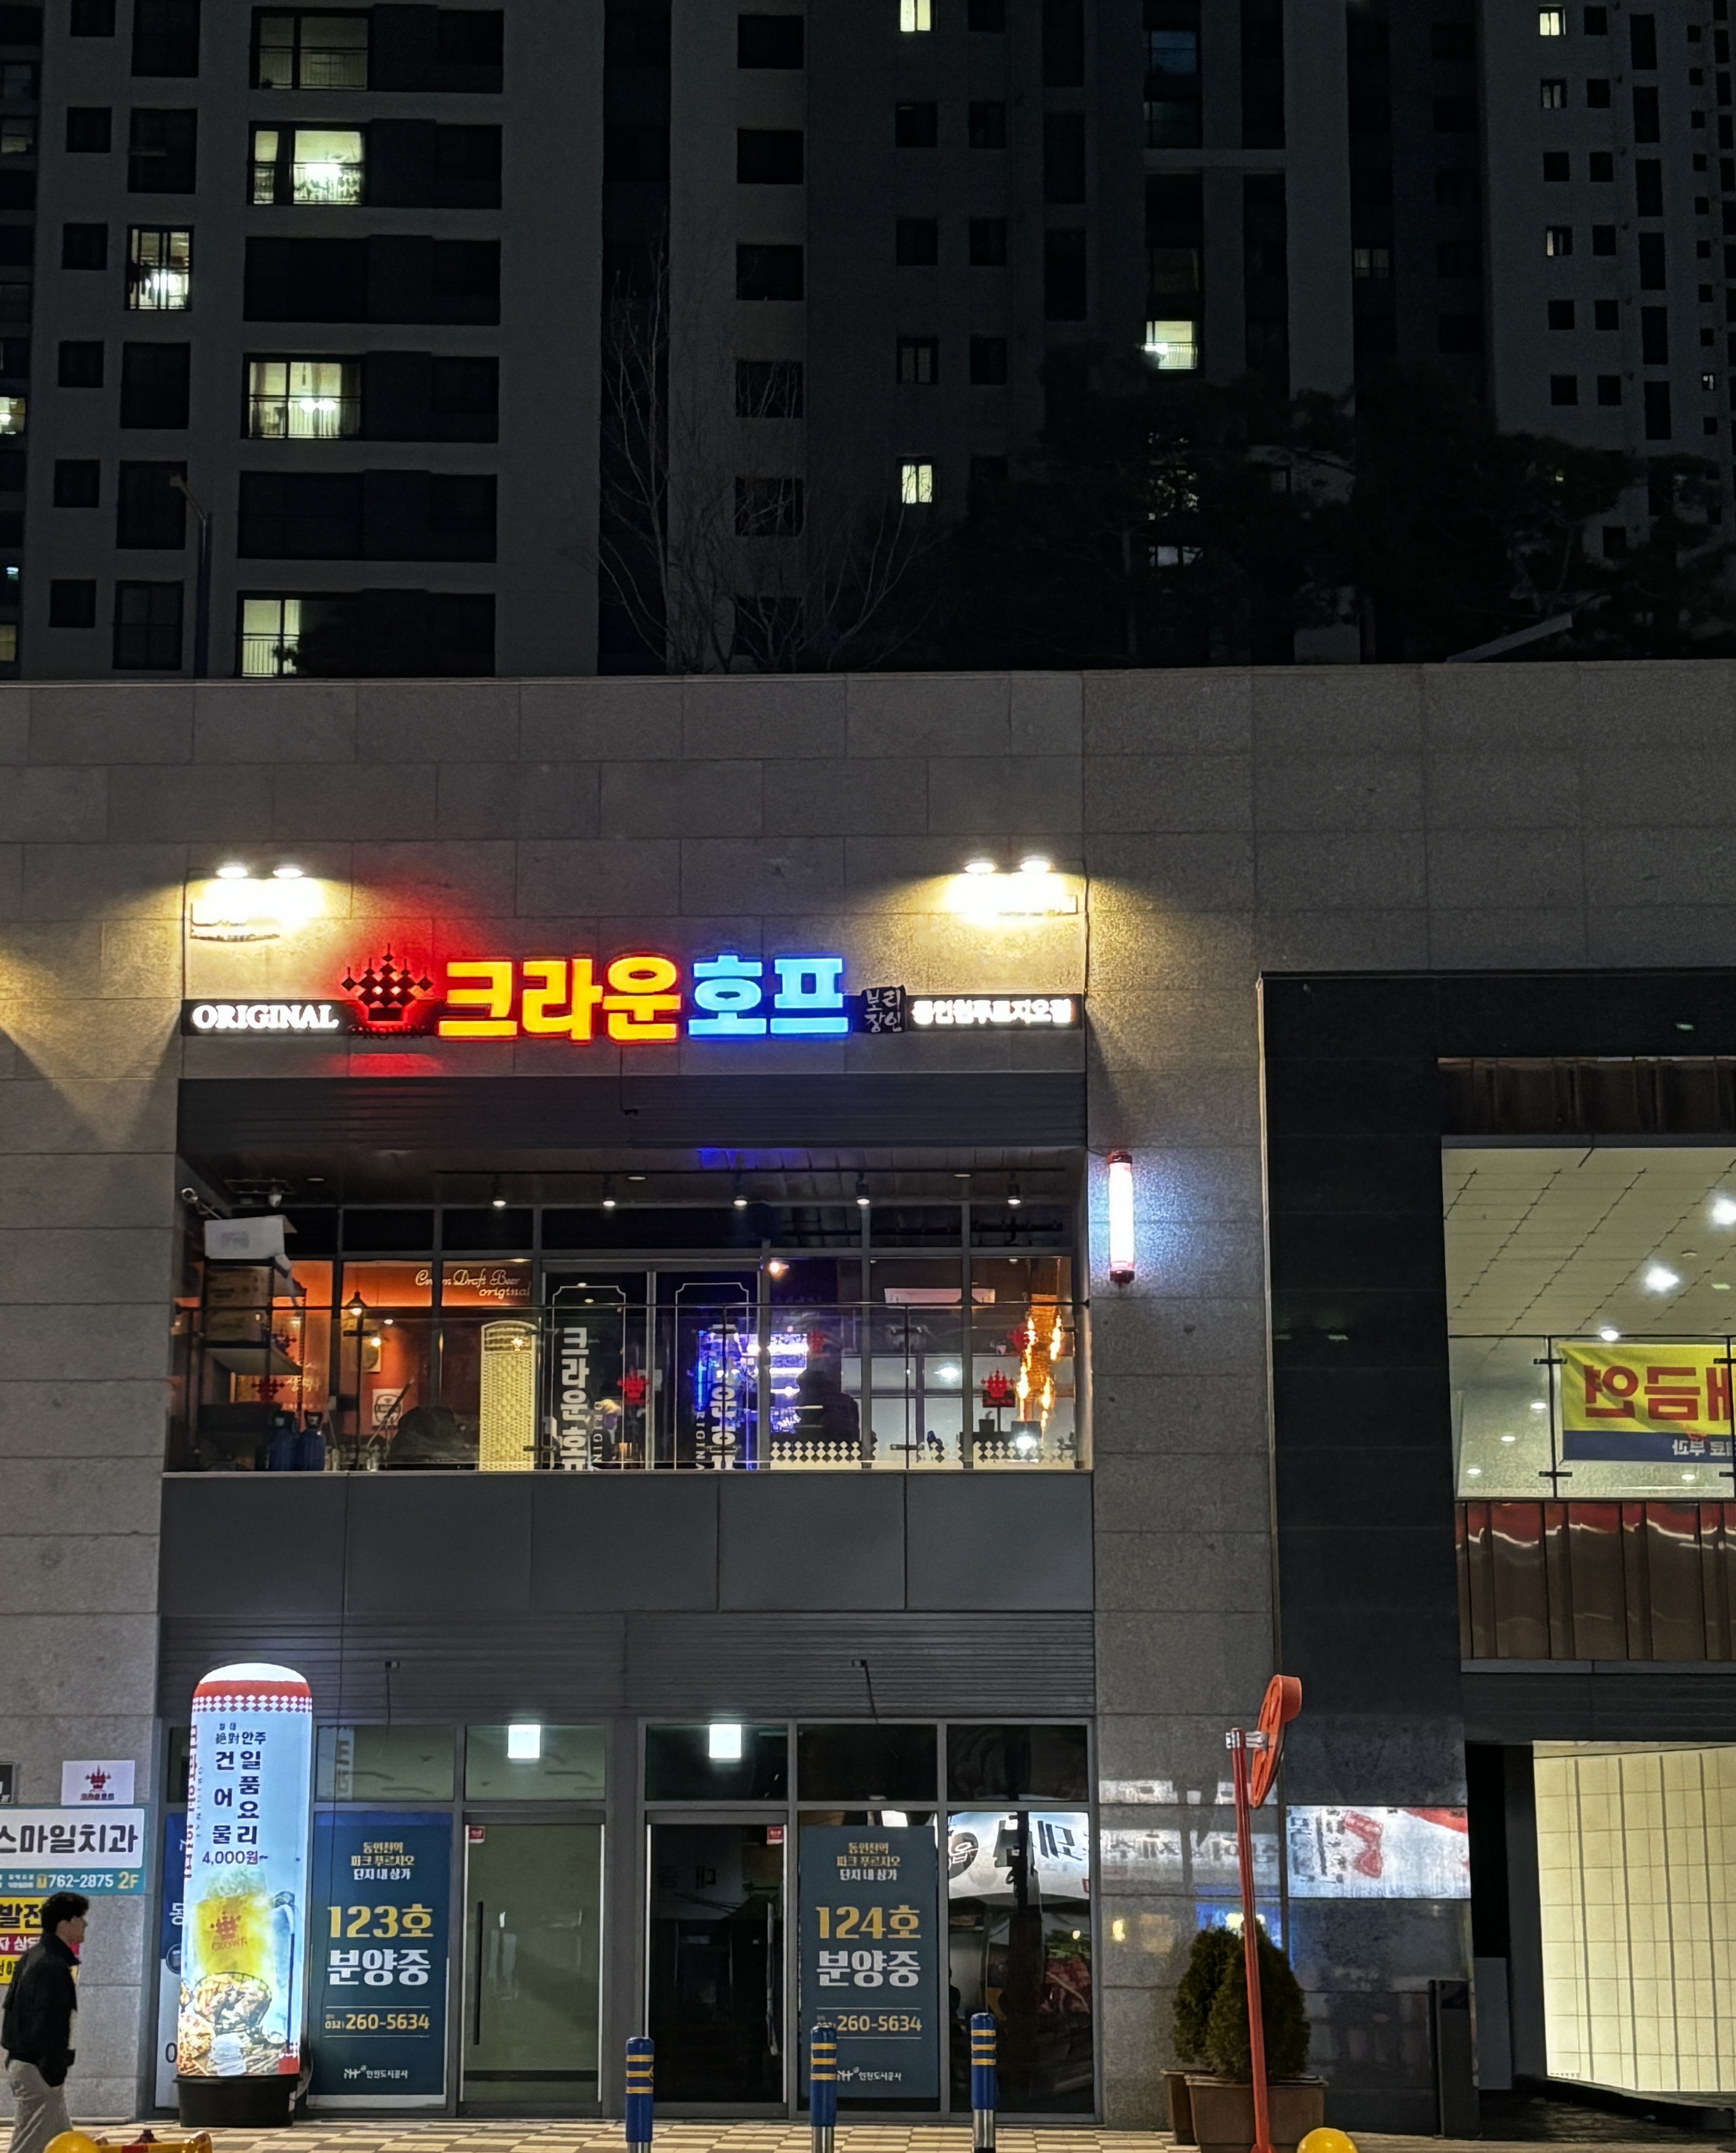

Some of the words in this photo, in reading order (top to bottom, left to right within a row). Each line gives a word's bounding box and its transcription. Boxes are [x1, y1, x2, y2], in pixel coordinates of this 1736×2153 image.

[437, 954, 851, 1042] 크라운호프
[866, 989, 901, 1011] 보리
[192, 1005, 340, 1029] ORIGINAL
[864, 1011, 902, 1033] 장인
[48, 1874, 114, 1888] 762-2875
[117, 1871, 139, 1889] 2F
[354, 1868, 375, 1880] 단지
[377, 1868, 388, 1880] 내
[390, 1868, 411, 1880] 상가
[840, 1868, 861, 1881] 단지
[863, 1868, 874, 1881] 내
[877, 1868, 897, 1881] 상가
[328, 1903, 434, 1938] 123호
[815, 1905, 921, 1939] 124호
[327, 1948, 431, 1986] 분양중
[816, 1949, 921, 1987] 분양중
[346, 2013, 430, 2030] 260-5634
[837, 2015, 922, 2032] 260-5634
